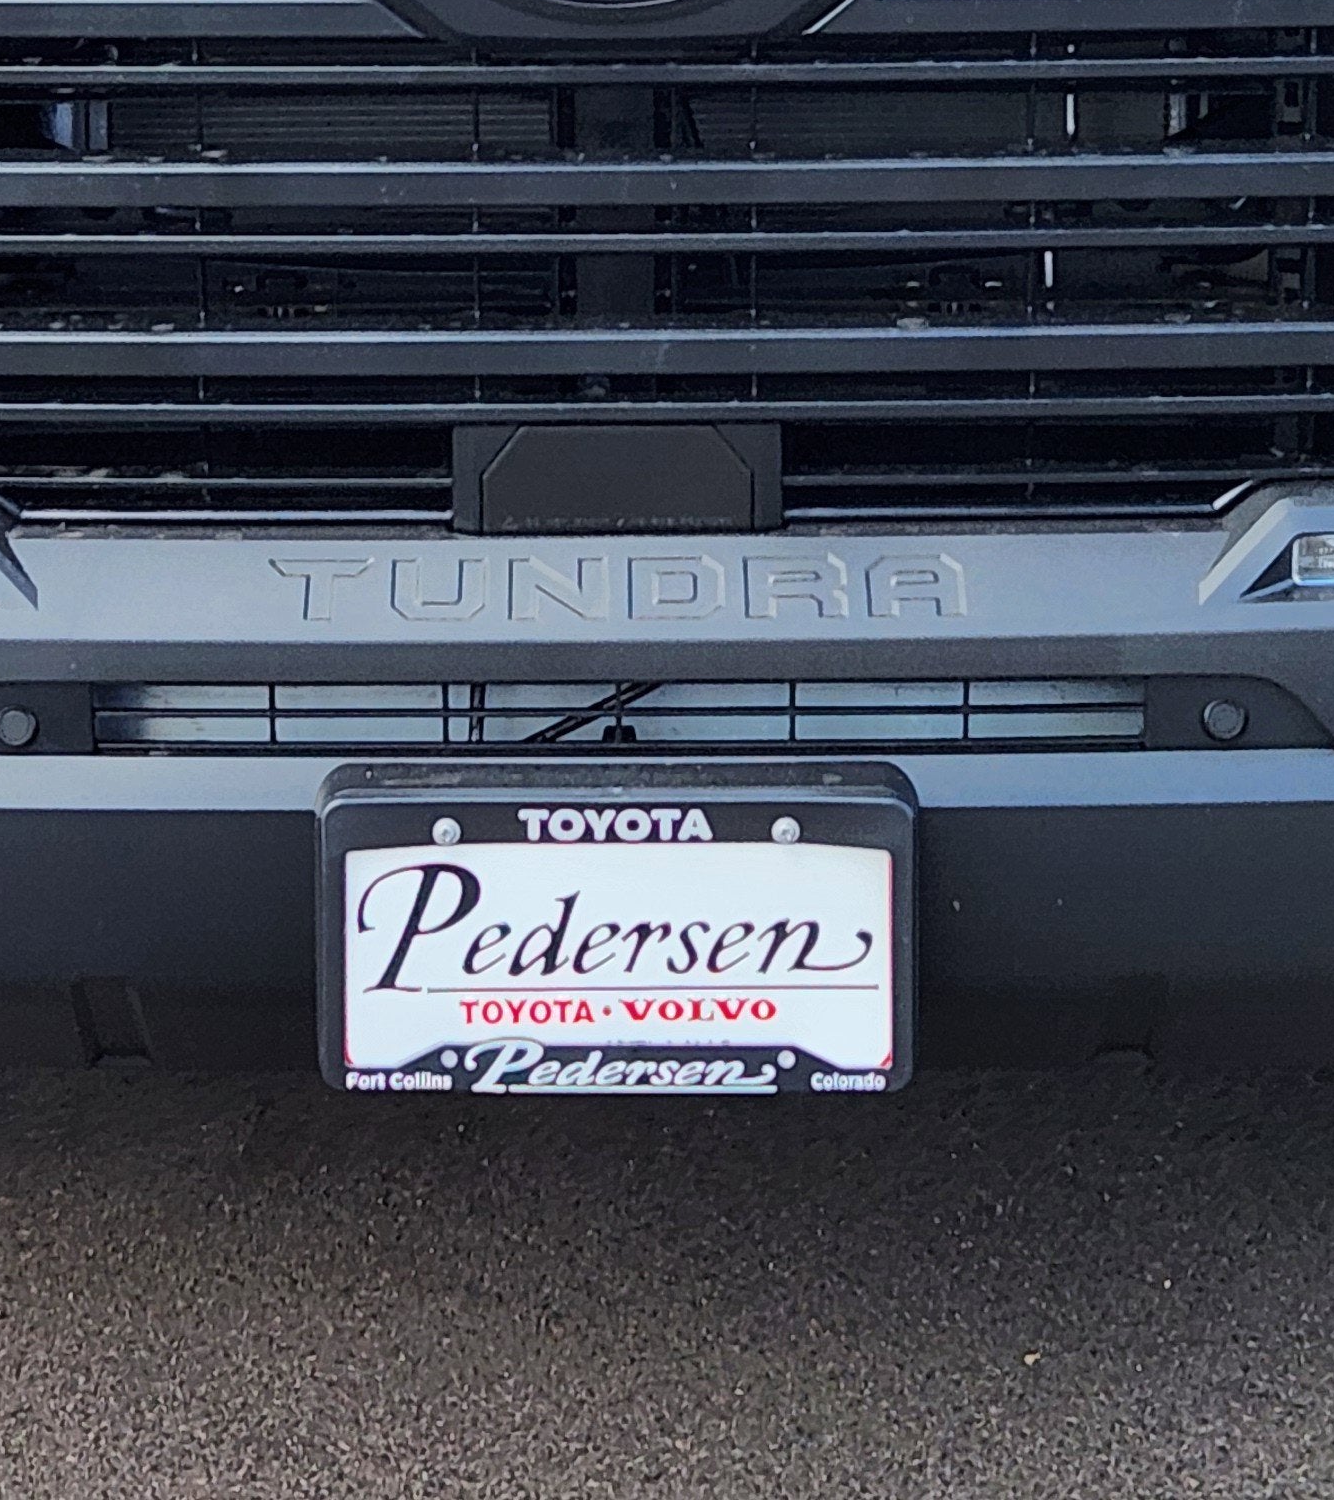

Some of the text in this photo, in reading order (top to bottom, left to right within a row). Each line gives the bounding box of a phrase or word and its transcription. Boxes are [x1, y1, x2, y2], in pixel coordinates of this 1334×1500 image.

[268, 556, 967, 620] TUNDRA
[517, 808, 713, 842] TOYOTA
[357, 863, 874, 993] Pedersen
[460, 998, 776, 1024] TOYOTA VOLVO
[345, 1071, 453, 1091] Fort Collins
[464, 1037, 777, 1093] Pedersen
[810, 1071, 886, 1092] Colorado
